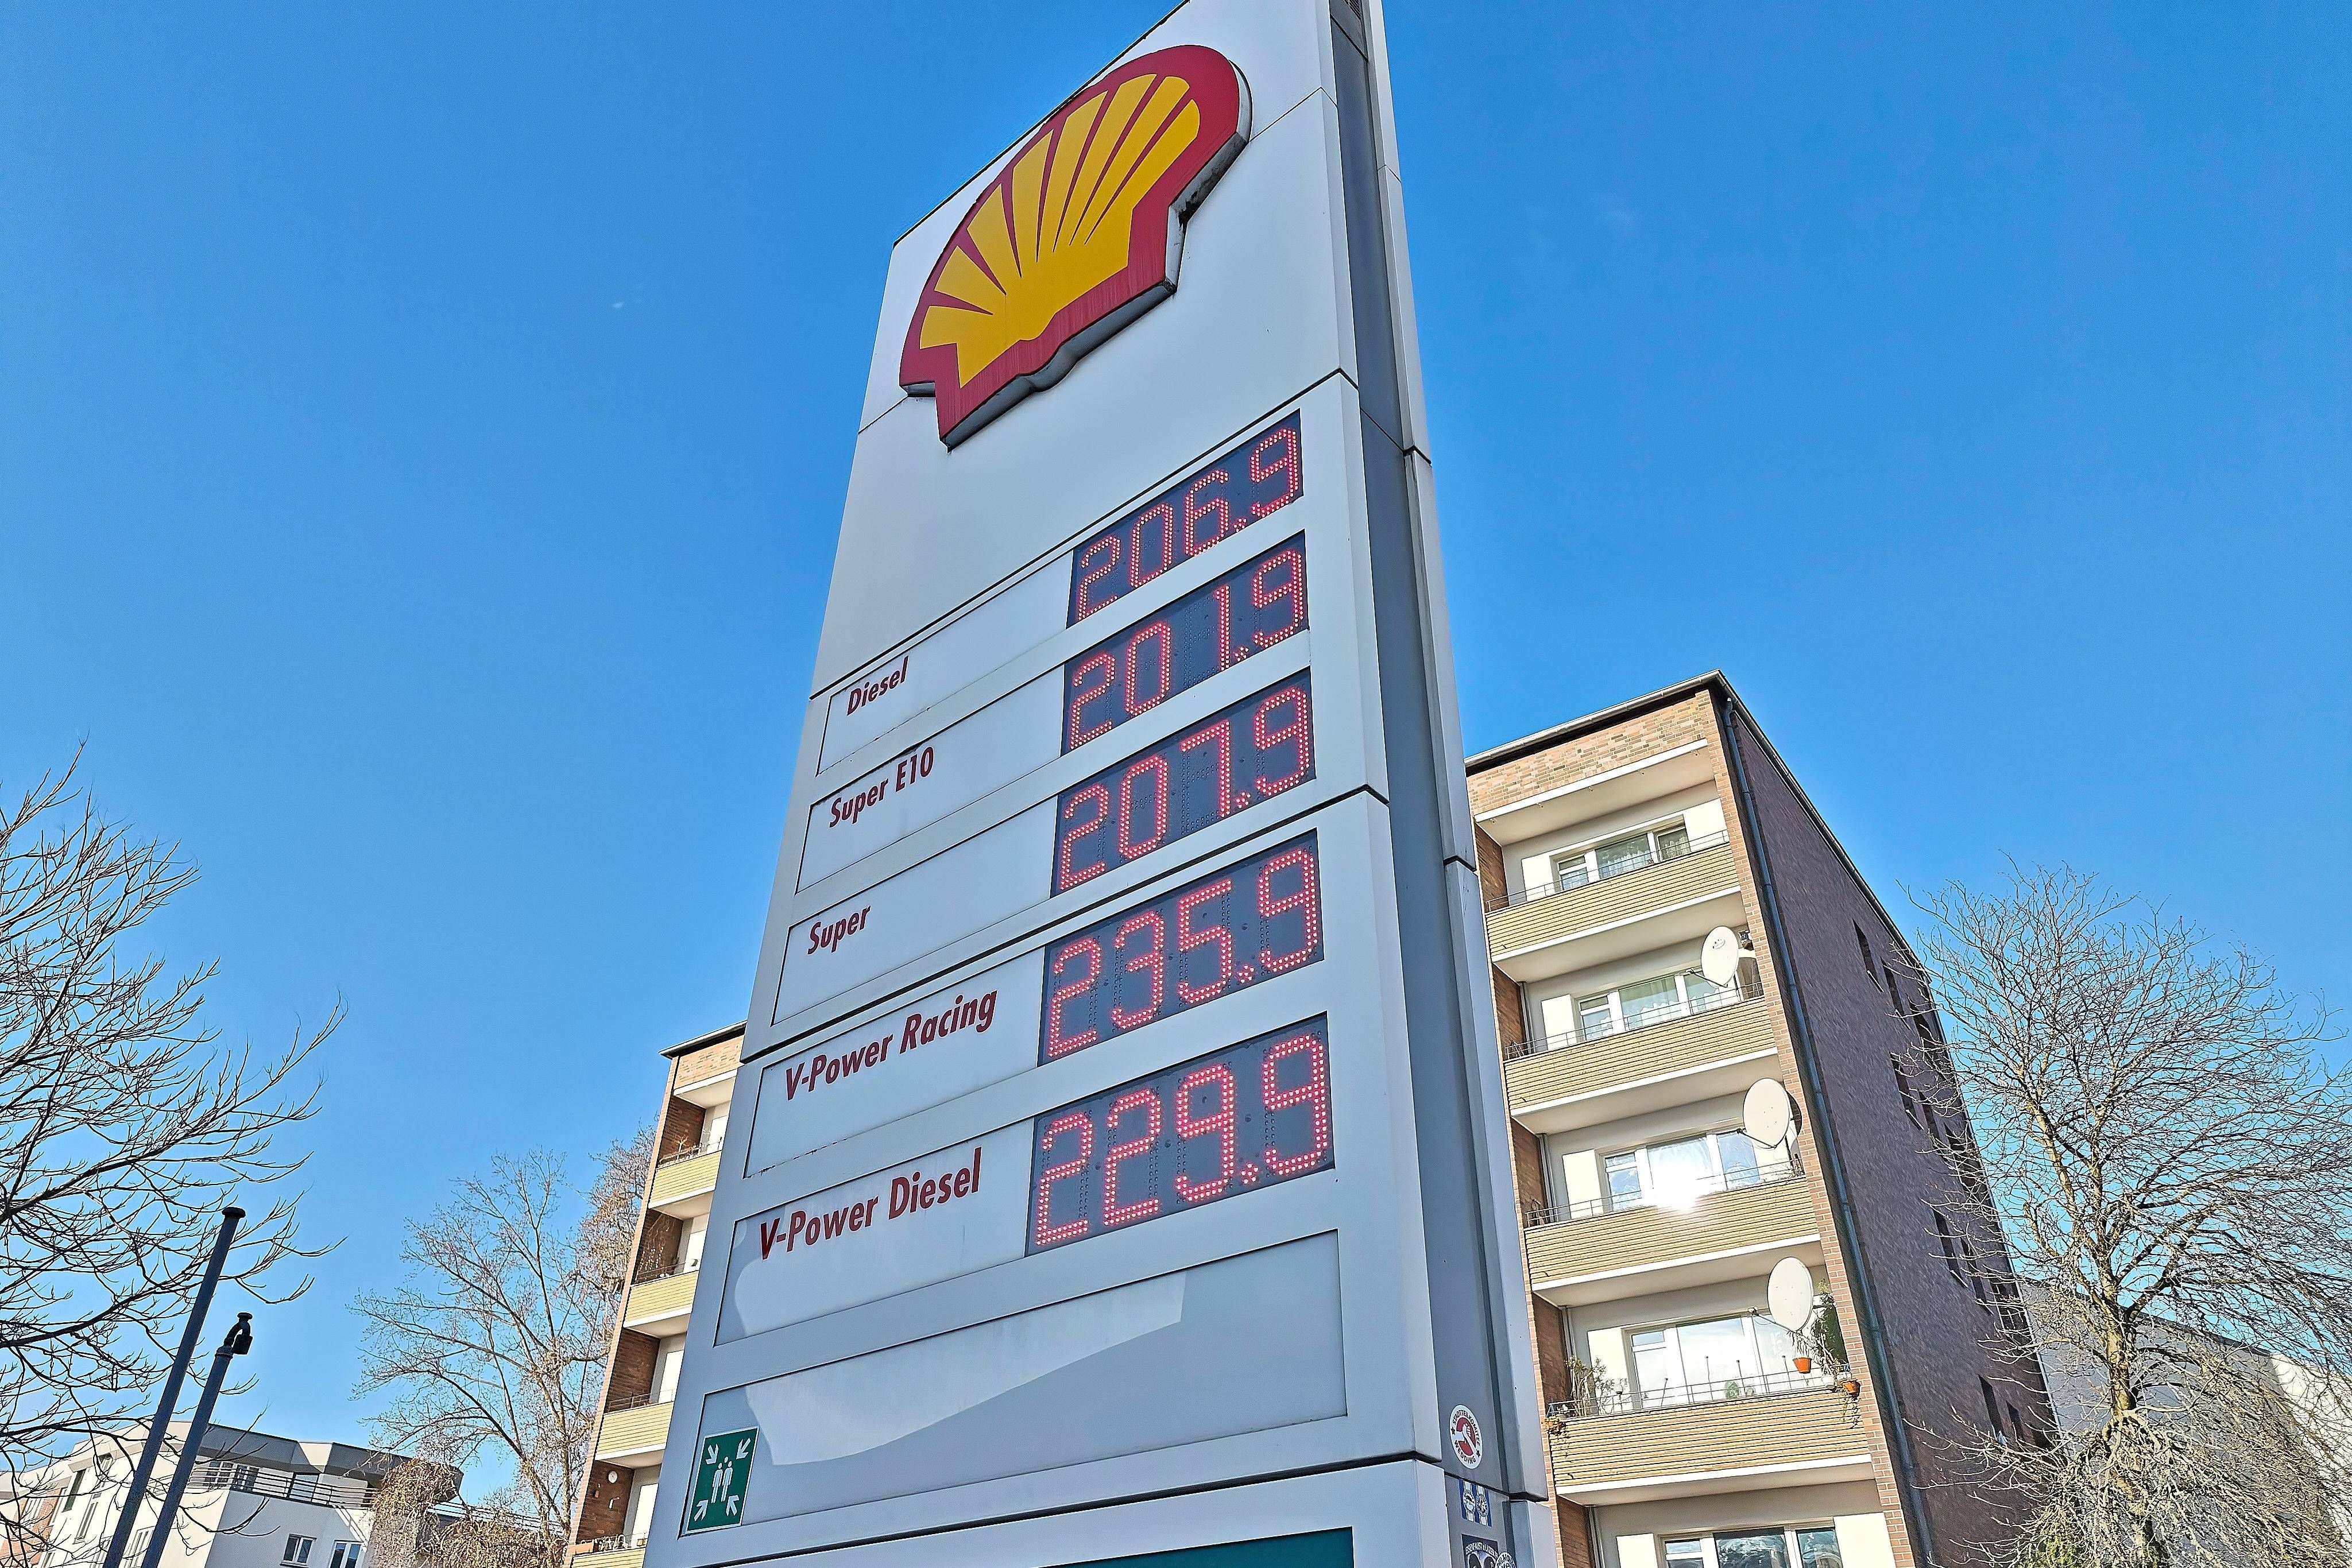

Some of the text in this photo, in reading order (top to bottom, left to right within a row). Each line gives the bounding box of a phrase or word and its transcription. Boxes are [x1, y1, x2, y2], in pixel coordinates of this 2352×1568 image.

[1076, 428, 1302, 622] 206.9
[847, 656, 908, 715] Diesel
[1069, 548, 1305, 751] 201.9
[829, 747, 934, 827] Super E10
[1059, 686, 1310, 892] 207.9
[808, 905, 871, 954] Super
[1048, 849, 1318, 1058] 235.9
[786, 990, 997, 1100] V-Power Racing
[1036, 1033, 1328, 1246] 229.9
[760, 1147, 982, 1260] V-Power Diesel
[1454, 1439, 1476, 1464] WEDDING
